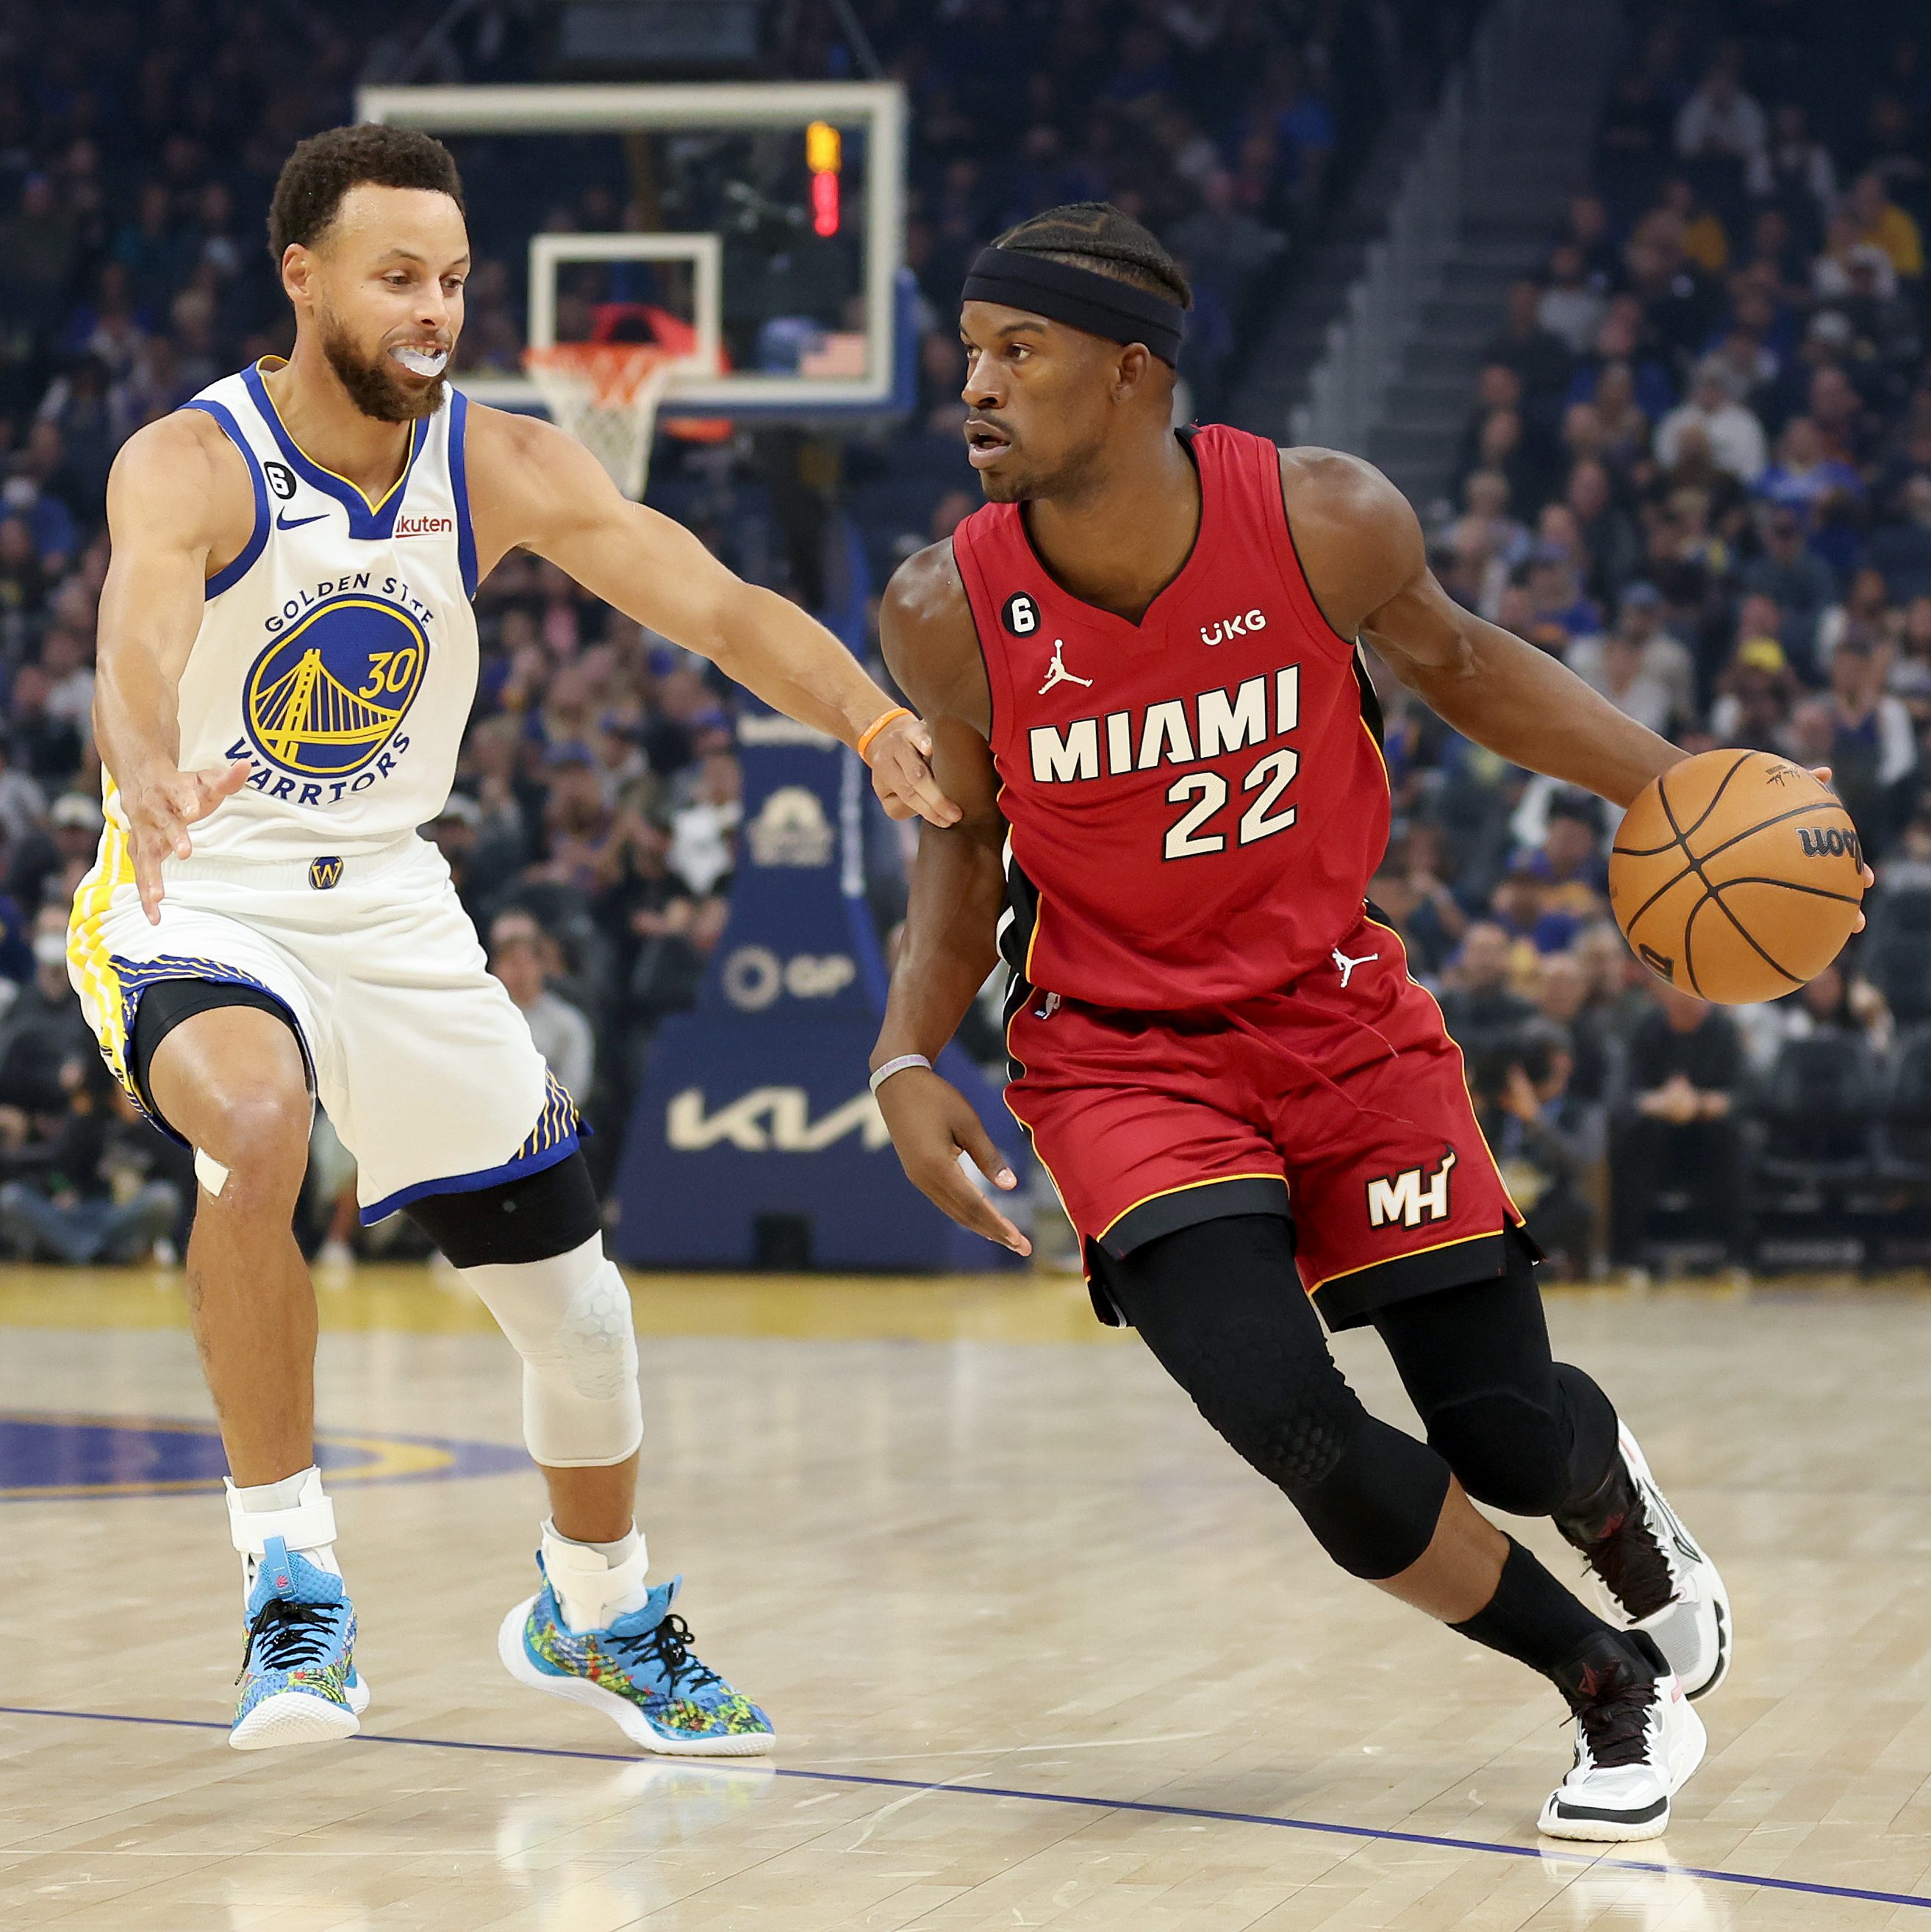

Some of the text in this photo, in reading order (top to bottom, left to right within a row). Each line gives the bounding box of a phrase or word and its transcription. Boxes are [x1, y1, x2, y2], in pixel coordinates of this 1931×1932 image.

[266, 465, 290, 495] 6
[265, 573, 370, 632] GOLDEN
[1011, 597, 1035, 633] 6
[359, 648, 418, 699] 30
[1029, 663, 1300, 784] MIAMI
[1161, 746, 1301, 862] 22
[311, 861, 342, 888] W
